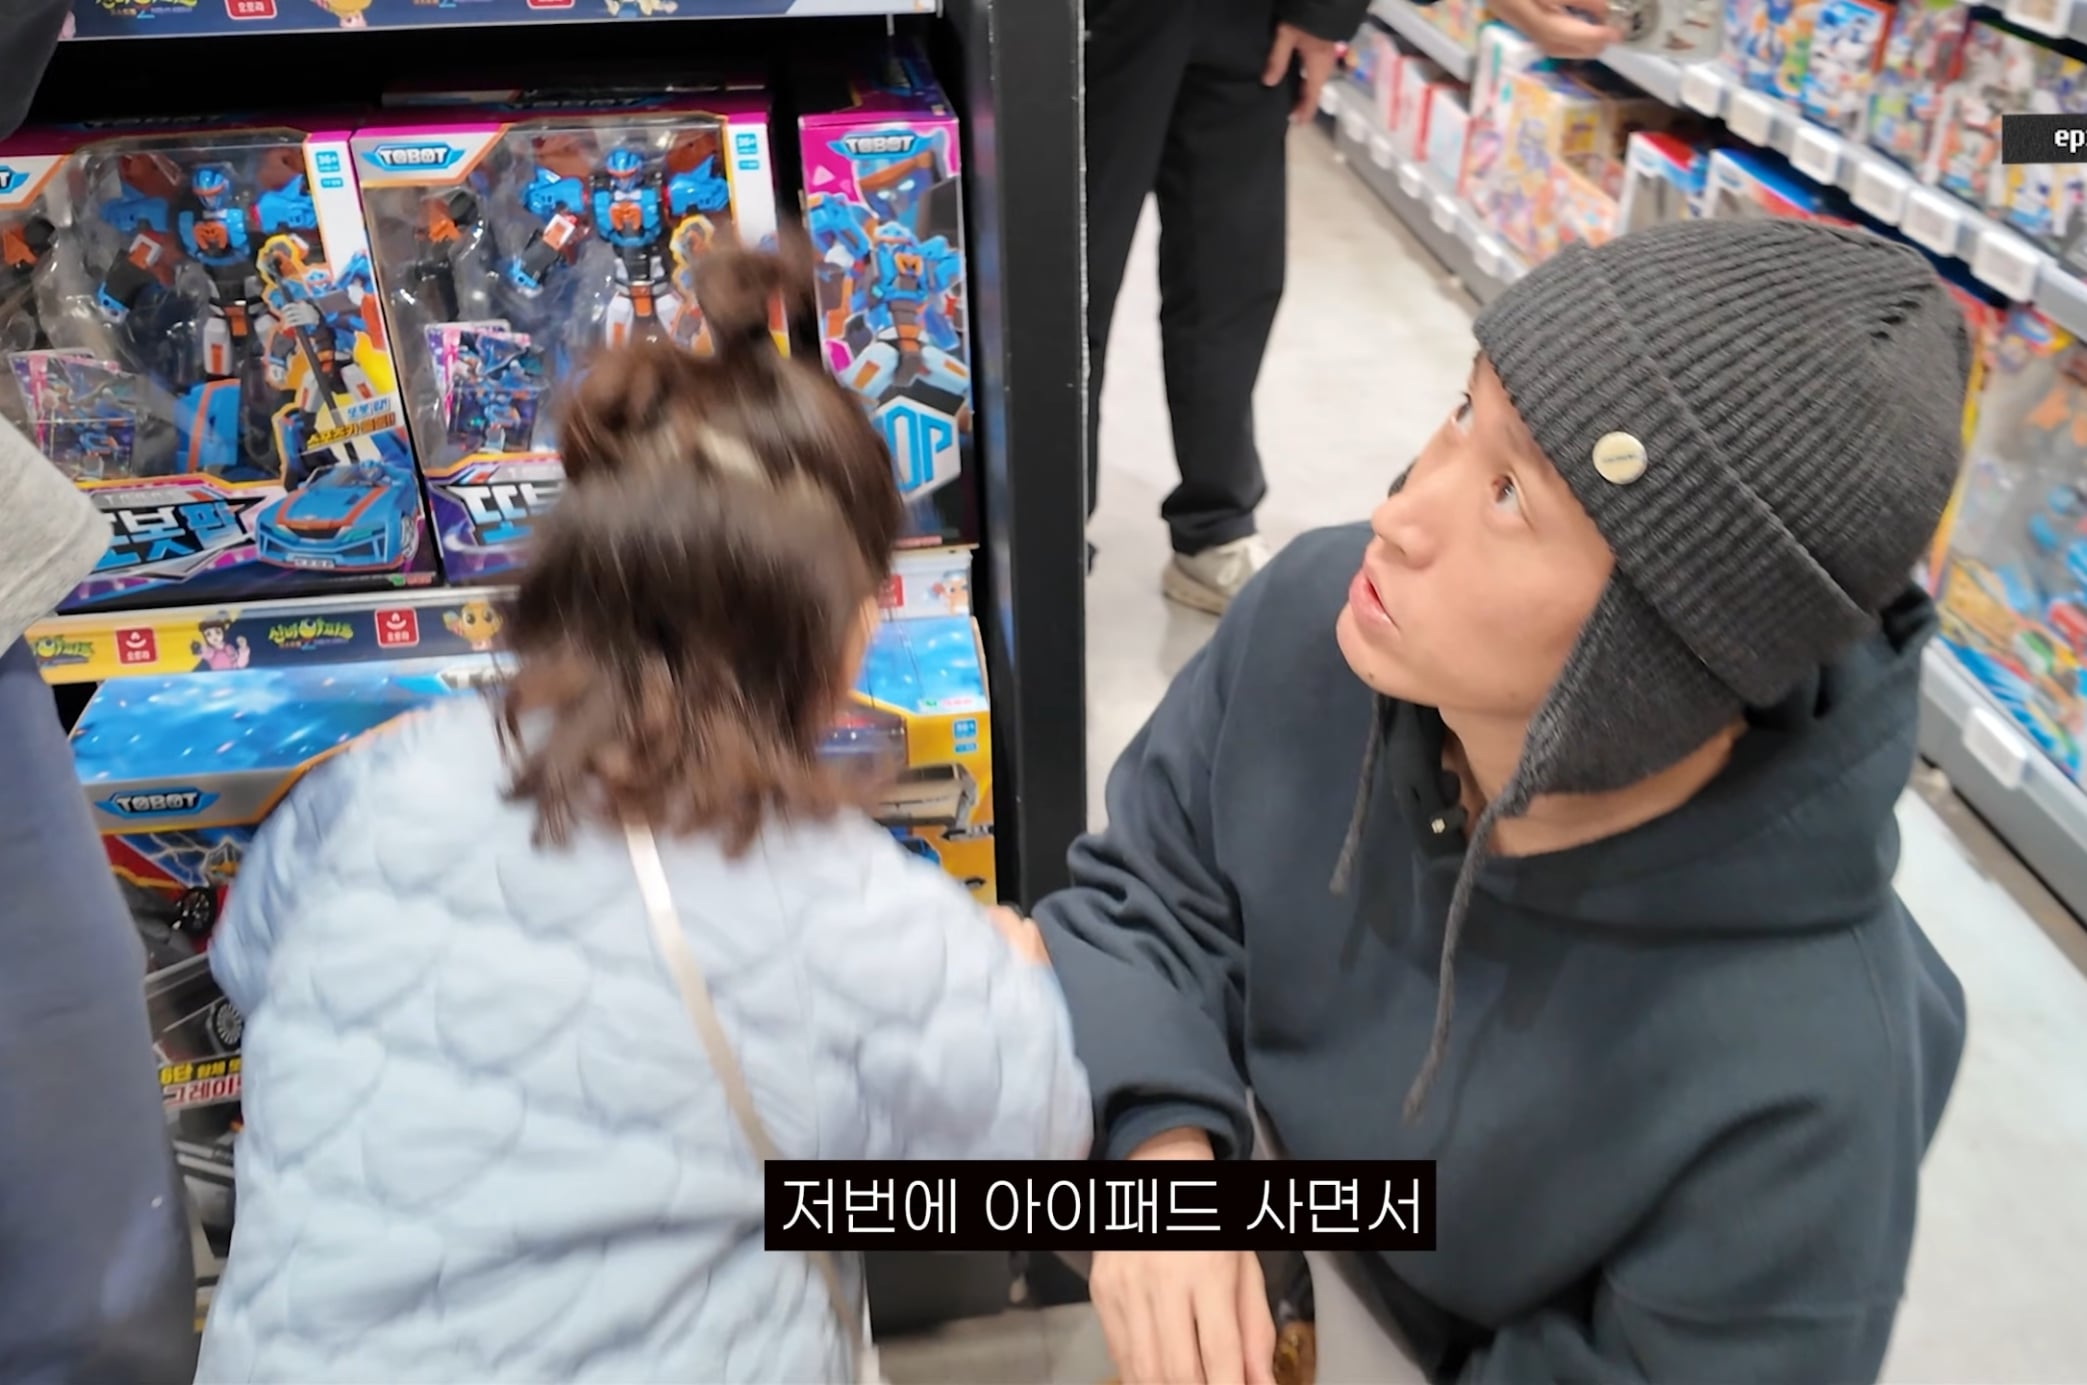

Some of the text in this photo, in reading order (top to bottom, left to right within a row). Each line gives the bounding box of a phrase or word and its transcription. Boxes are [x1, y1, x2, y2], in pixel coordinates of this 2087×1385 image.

[841, 136, 915, 155] TOBOT
[380, 147, 448, 166] TOBOT
[116, 791, 198, 813] TOBOT
[163, 1075, 242, 1105] 그레이
